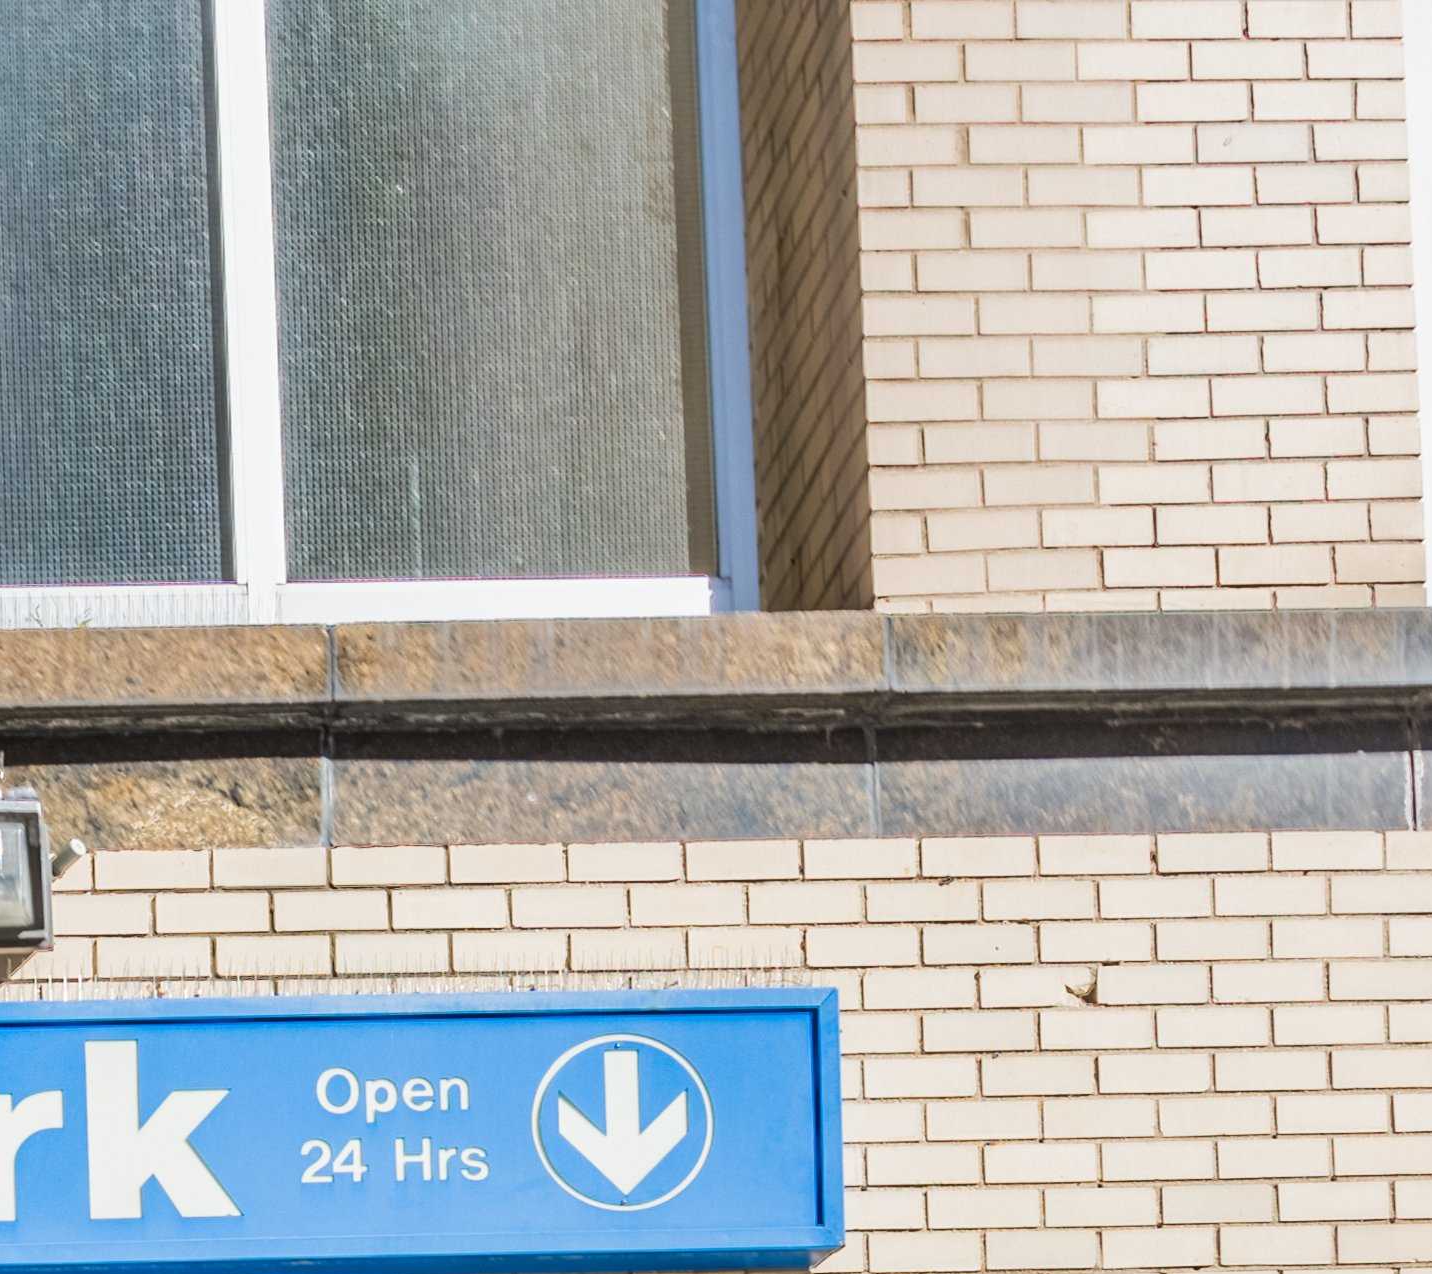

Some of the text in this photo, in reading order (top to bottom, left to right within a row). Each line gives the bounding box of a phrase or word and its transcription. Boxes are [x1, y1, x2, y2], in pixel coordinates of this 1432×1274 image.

[314, 1066, 471, 1125] Open
[299, 1136, 491, 1185] 24 Hrs
